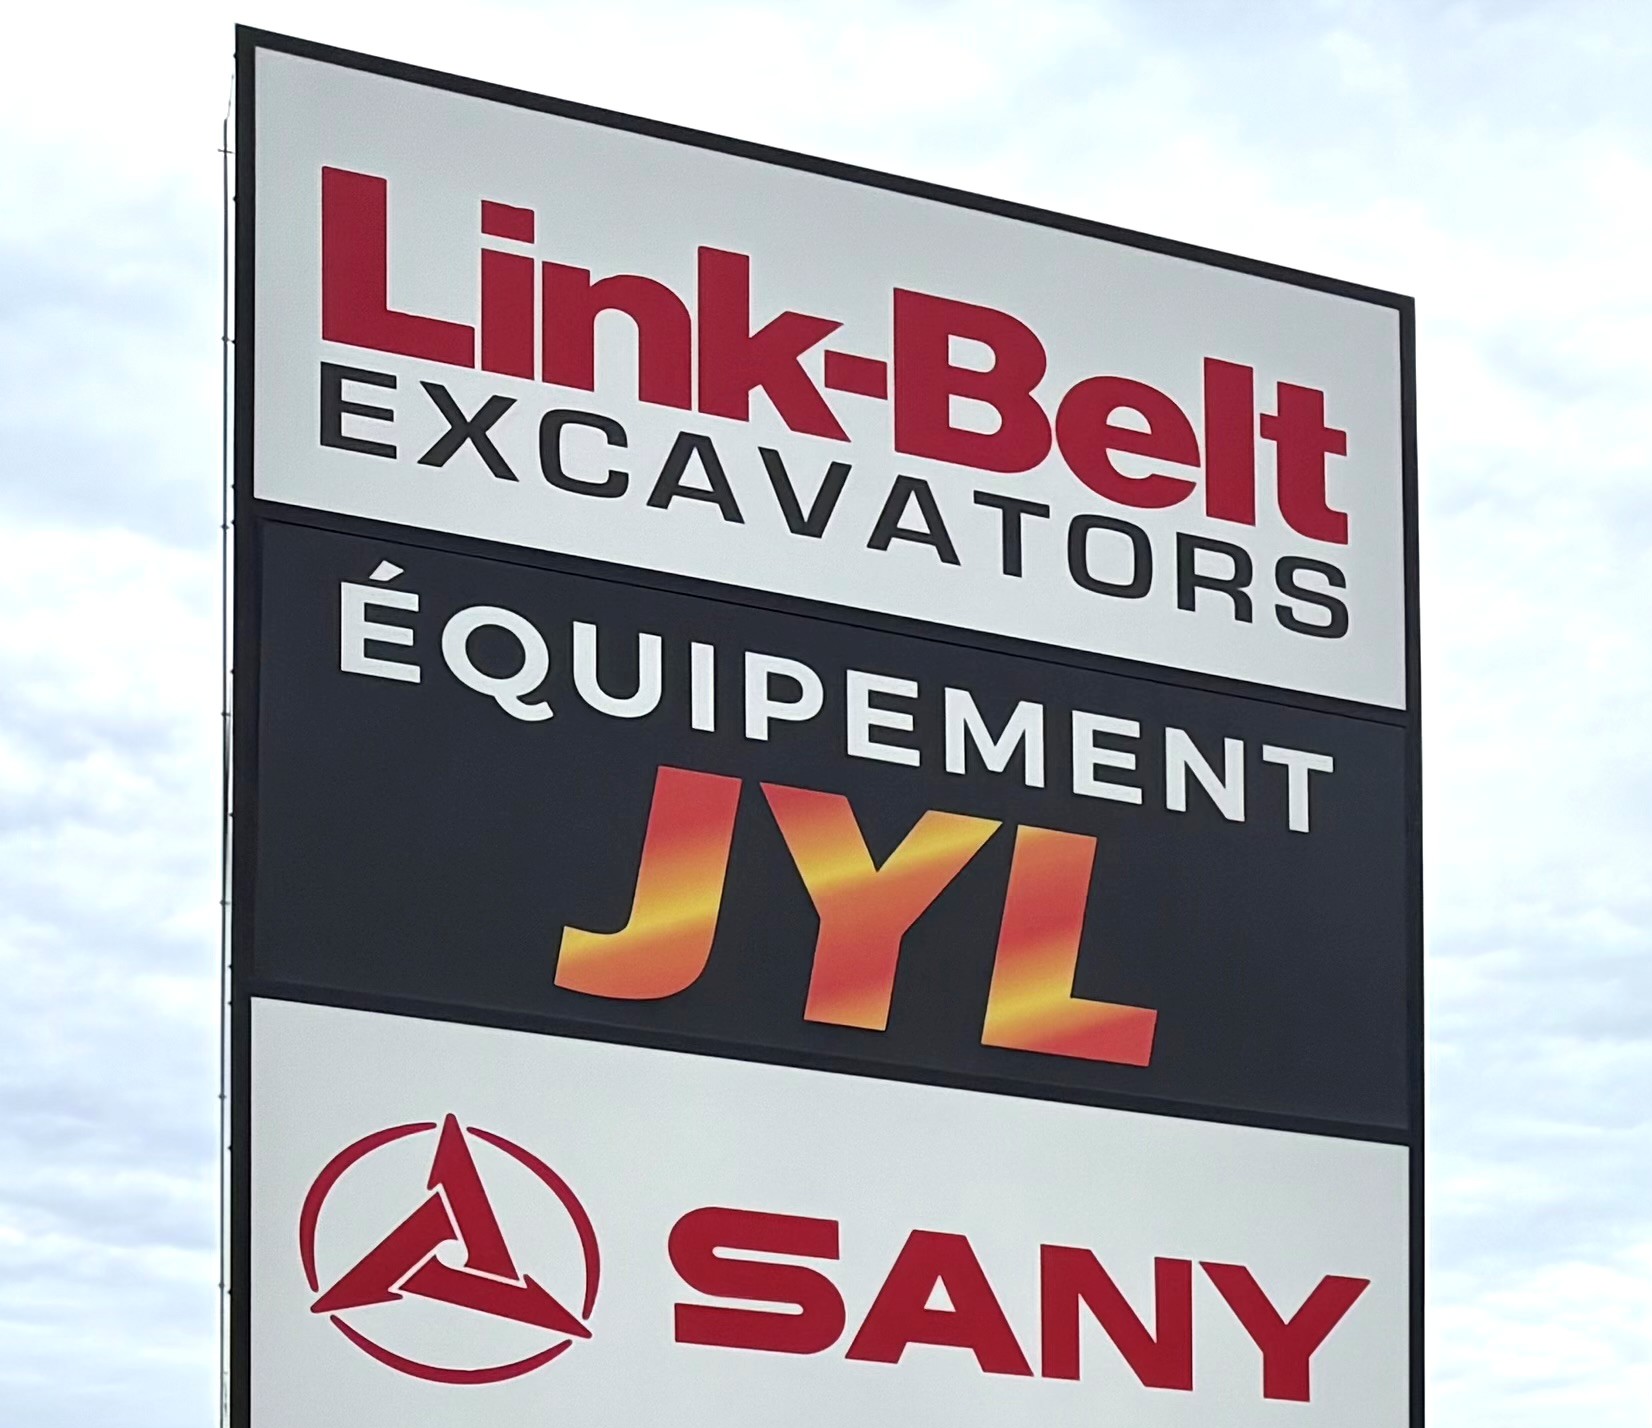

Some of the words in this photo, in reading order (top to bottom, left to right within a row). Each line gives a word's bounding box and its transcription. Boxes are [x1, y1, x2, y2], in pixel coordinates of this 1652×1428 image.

[321, 166, 1349, 545] Link-Belt
[318, 361, 1350, 640] EXCAVATORS
[340, 560, 1334, 833] ÉQUIPEMENT
[553, 765, 1158, 1067] JYL
[667, 1206, 1370, 1403] SANY
